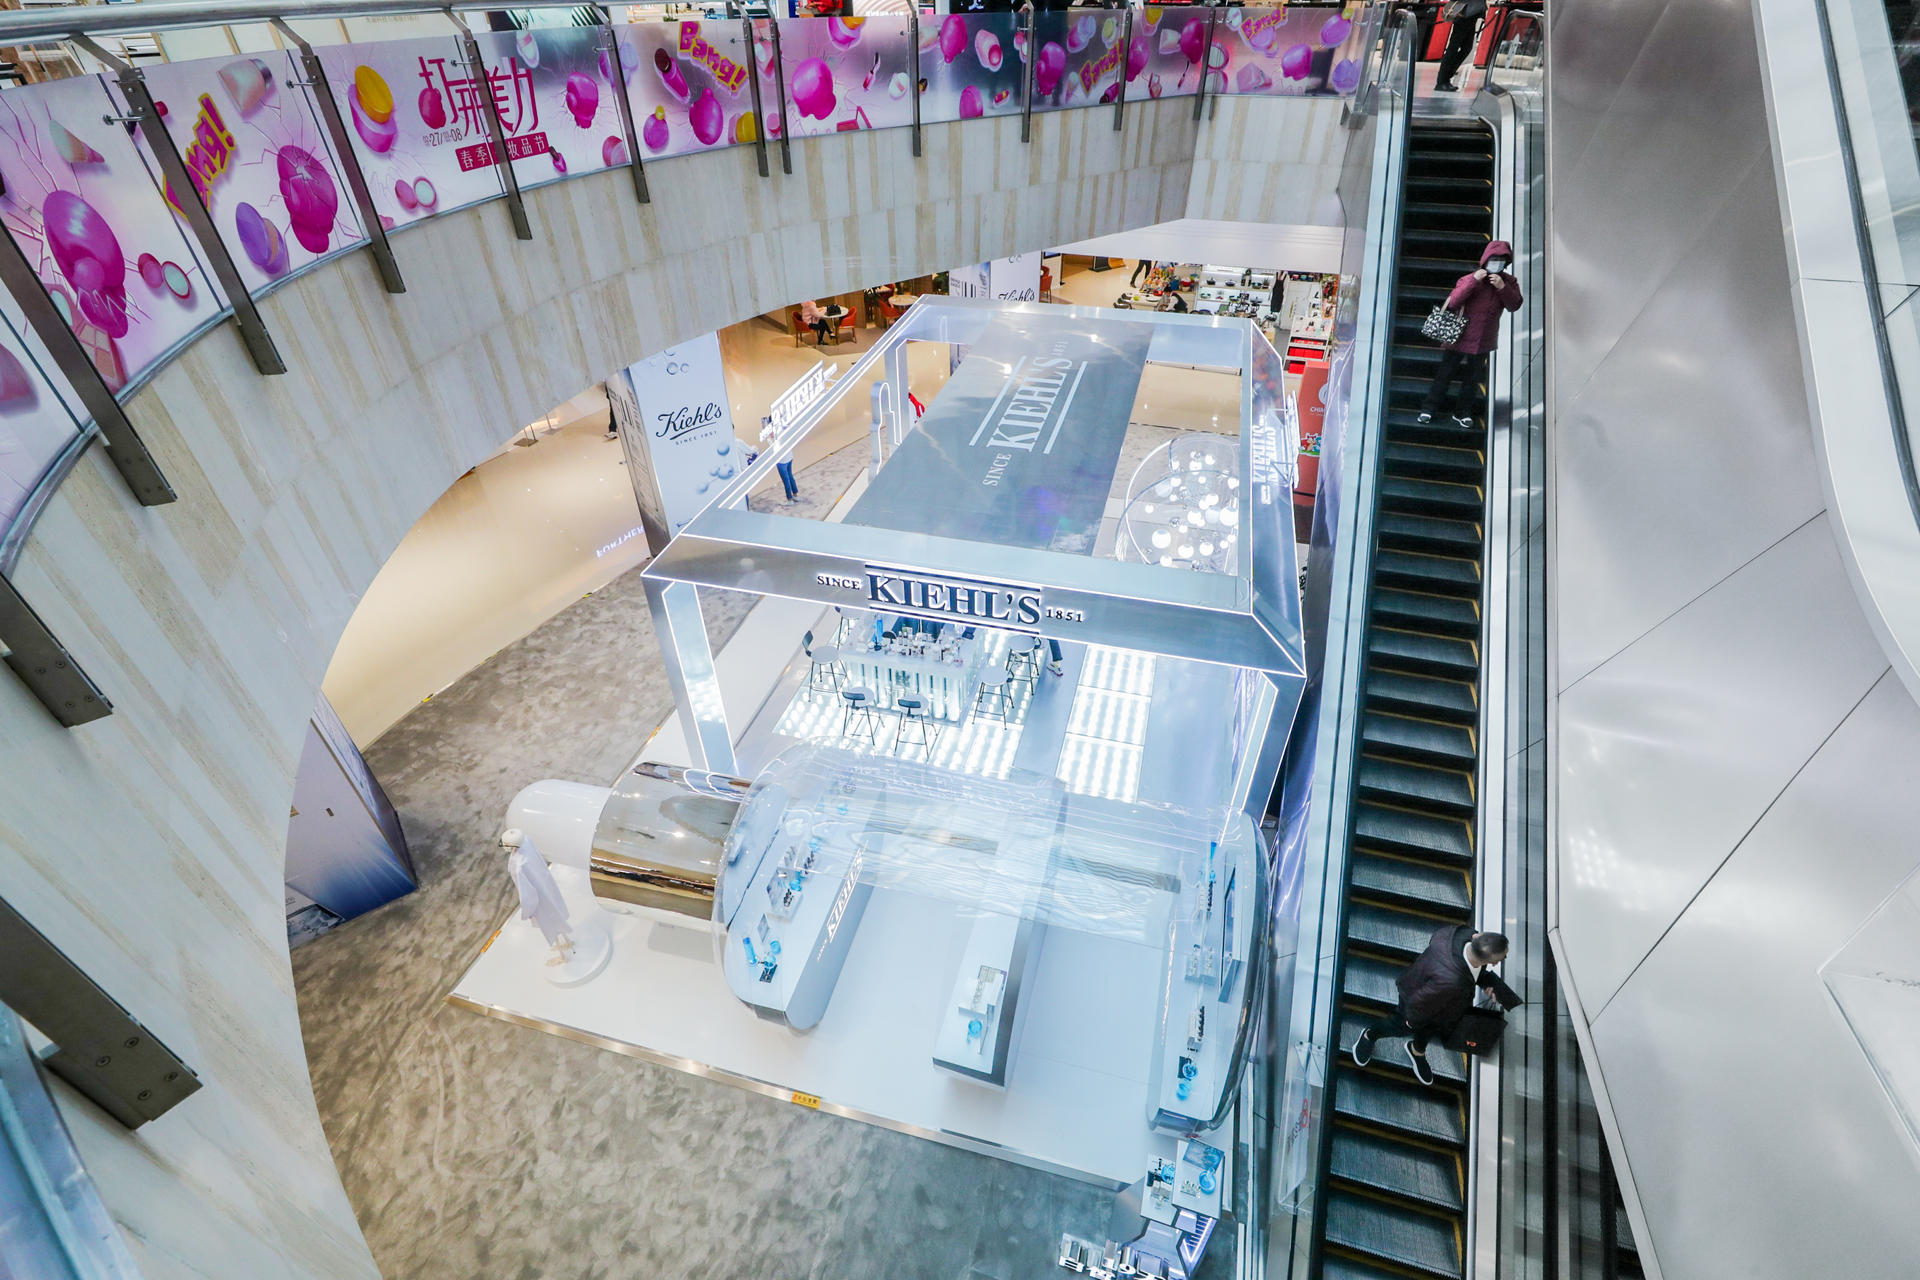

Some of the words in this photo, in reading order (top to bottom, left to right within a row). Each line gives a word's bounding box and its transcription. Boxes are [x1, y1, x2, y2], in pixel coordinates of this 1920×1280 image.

[1241, 5, 1288, 41] Bang!
[679, 20, 749, 93] Bang!
[1079, 37, 1125, 95] Bang!
[460, 135, 545, 169] 春季妆品节
[655, 402, 722, 438] Kiehl's
[986, 355, 1073, 453] KIEHL'S
[983, 452, 1012, 487] SINCE
[817, 574, 860, 590] SINCE
[865, 573, 1041, 625] KIEHL'S
[1046, 608, 1084, 623] 1851
